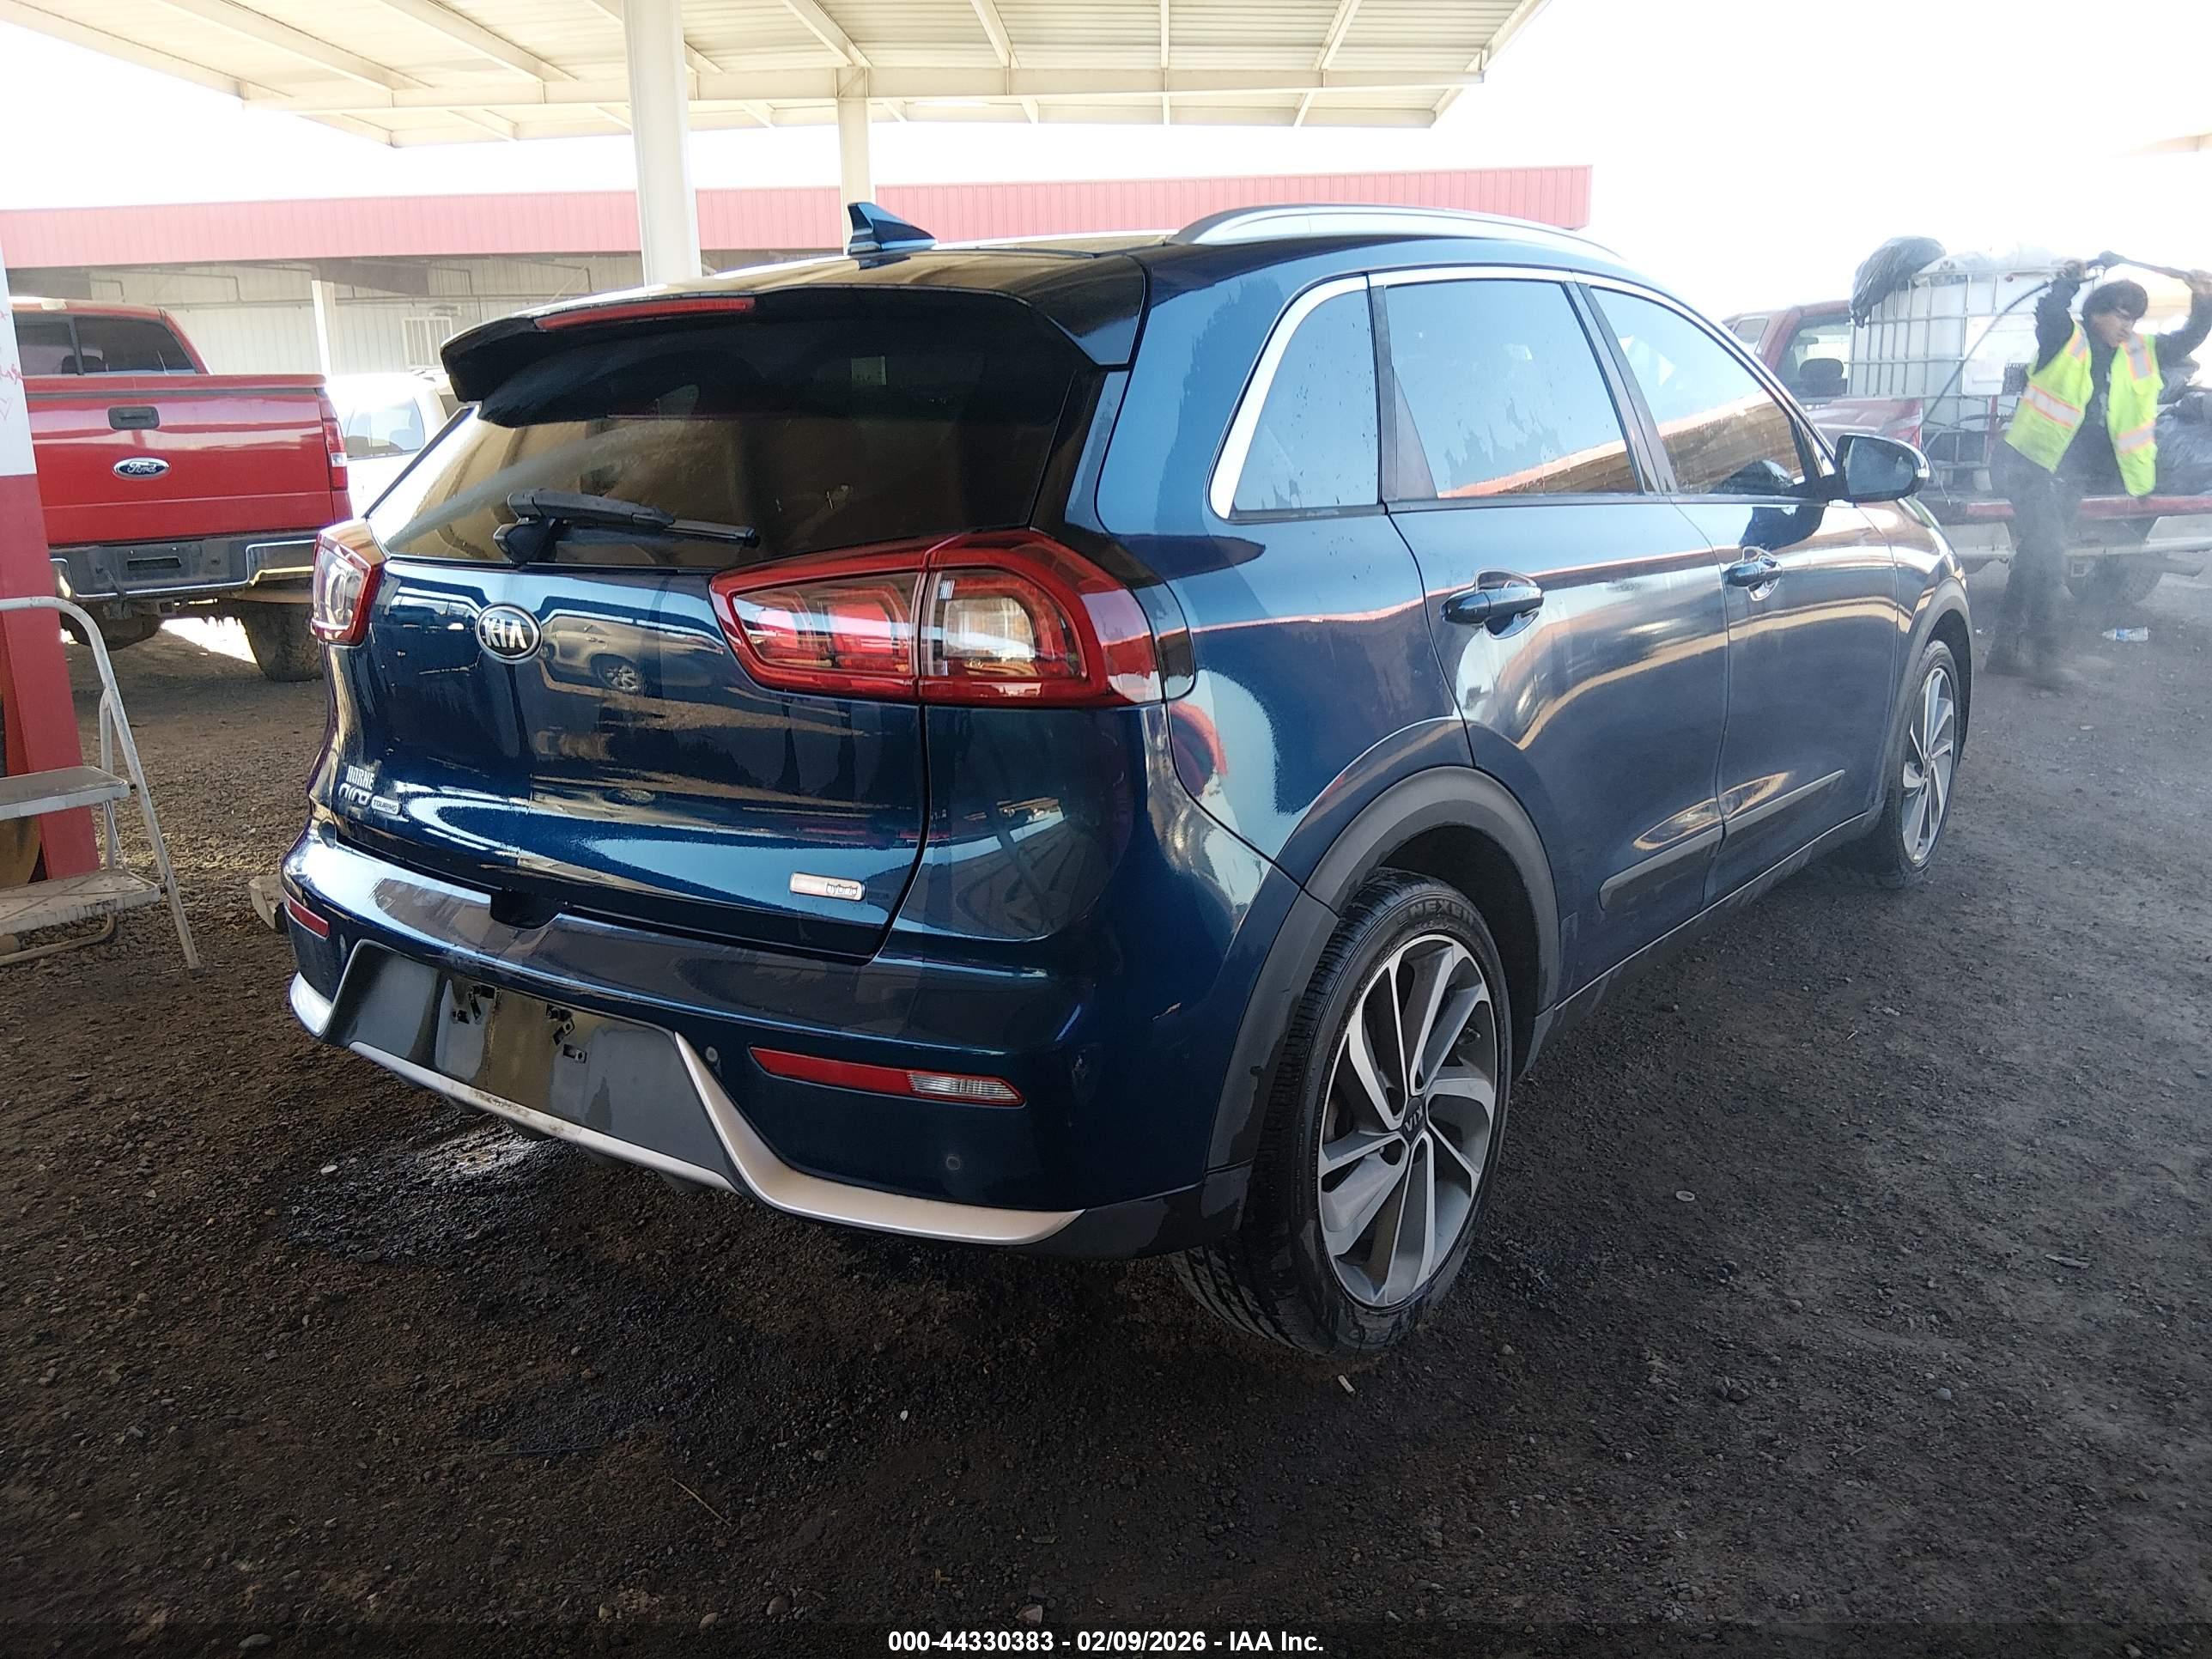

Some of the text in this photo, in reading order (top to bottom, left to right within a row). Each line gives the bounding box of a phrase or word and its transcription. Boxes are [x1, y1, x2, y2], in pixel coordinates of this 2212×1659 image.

[127, 460, 157, 474] Ford
[483, 617, 528, 649] KIA
[373, 799, 398, 812] TOURING
[1404, 1104, 1424, 1132] KIA
